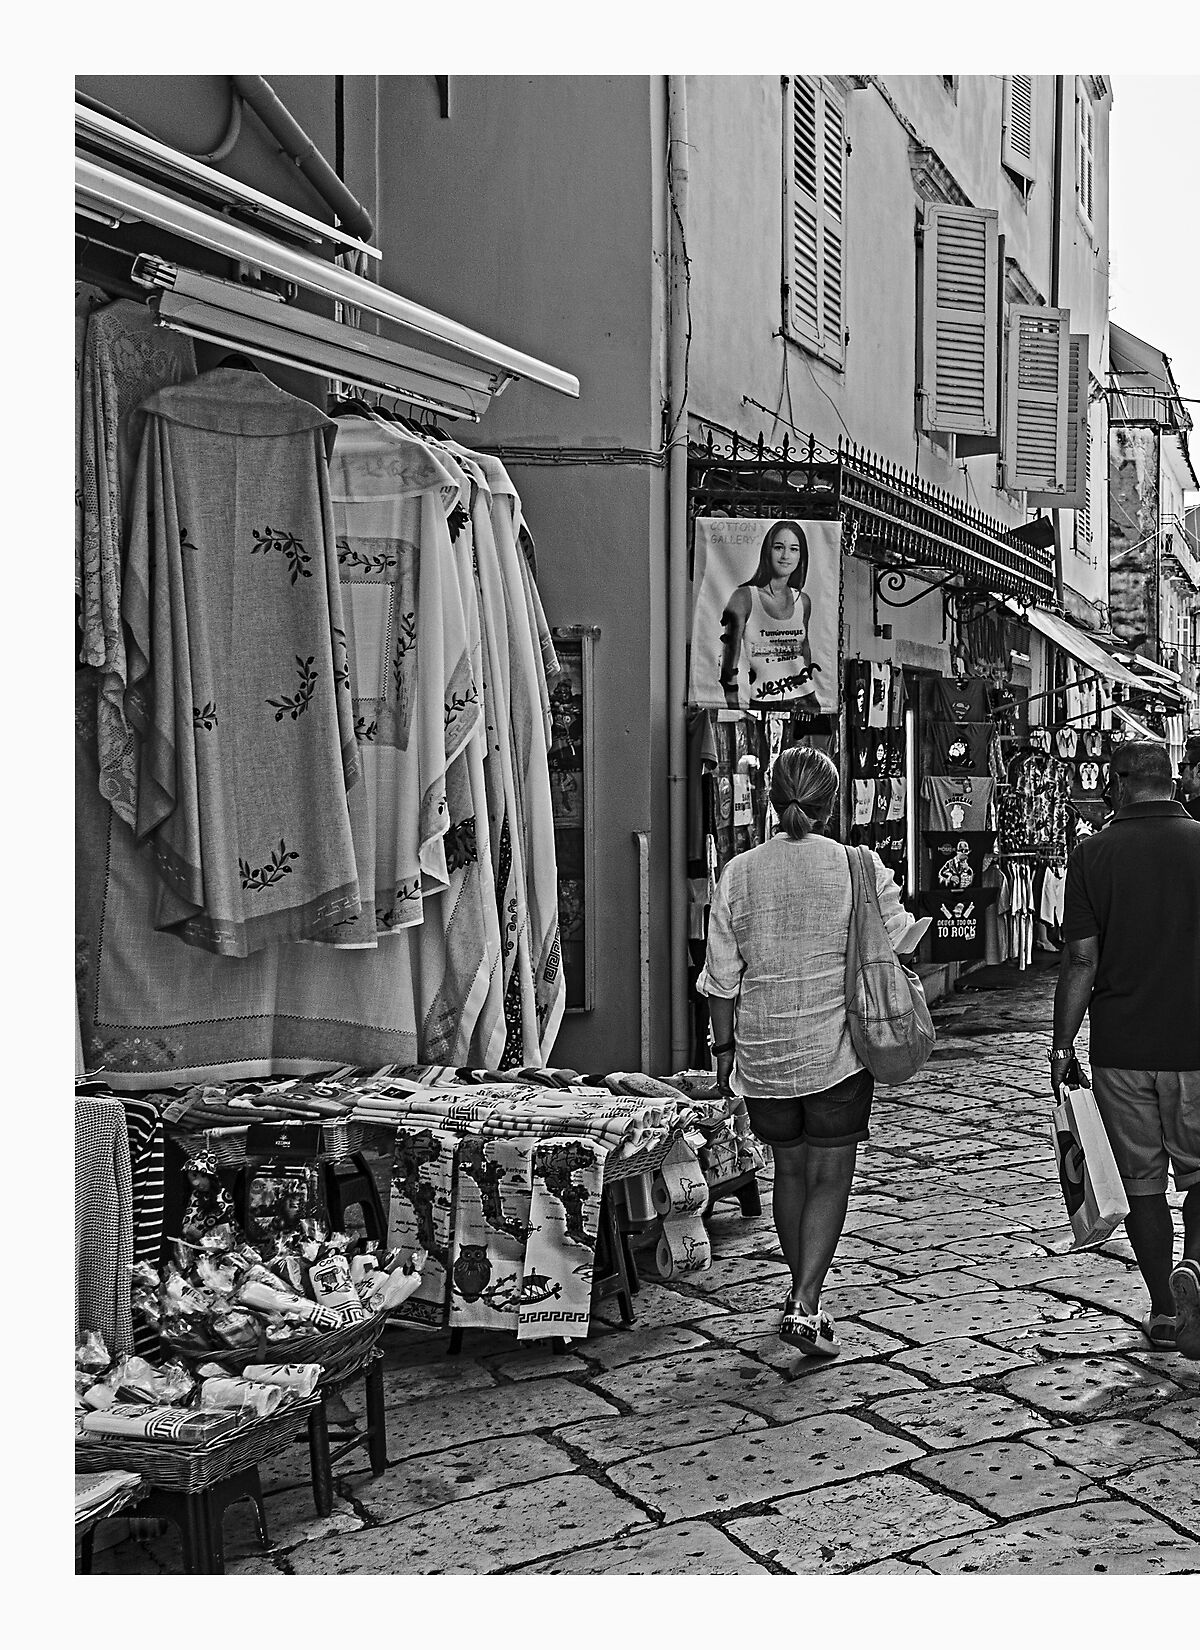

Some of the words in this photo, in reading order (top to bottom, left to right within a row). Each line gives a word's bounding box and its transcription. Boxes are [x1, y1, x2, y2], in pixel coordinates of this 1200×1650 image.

[710, 521, 757, 531] COTTON
[710, 534, 760, 545] GALLERY
[937, 926, 949, 938] TO
[951, 925, 977, 938] ROCK
